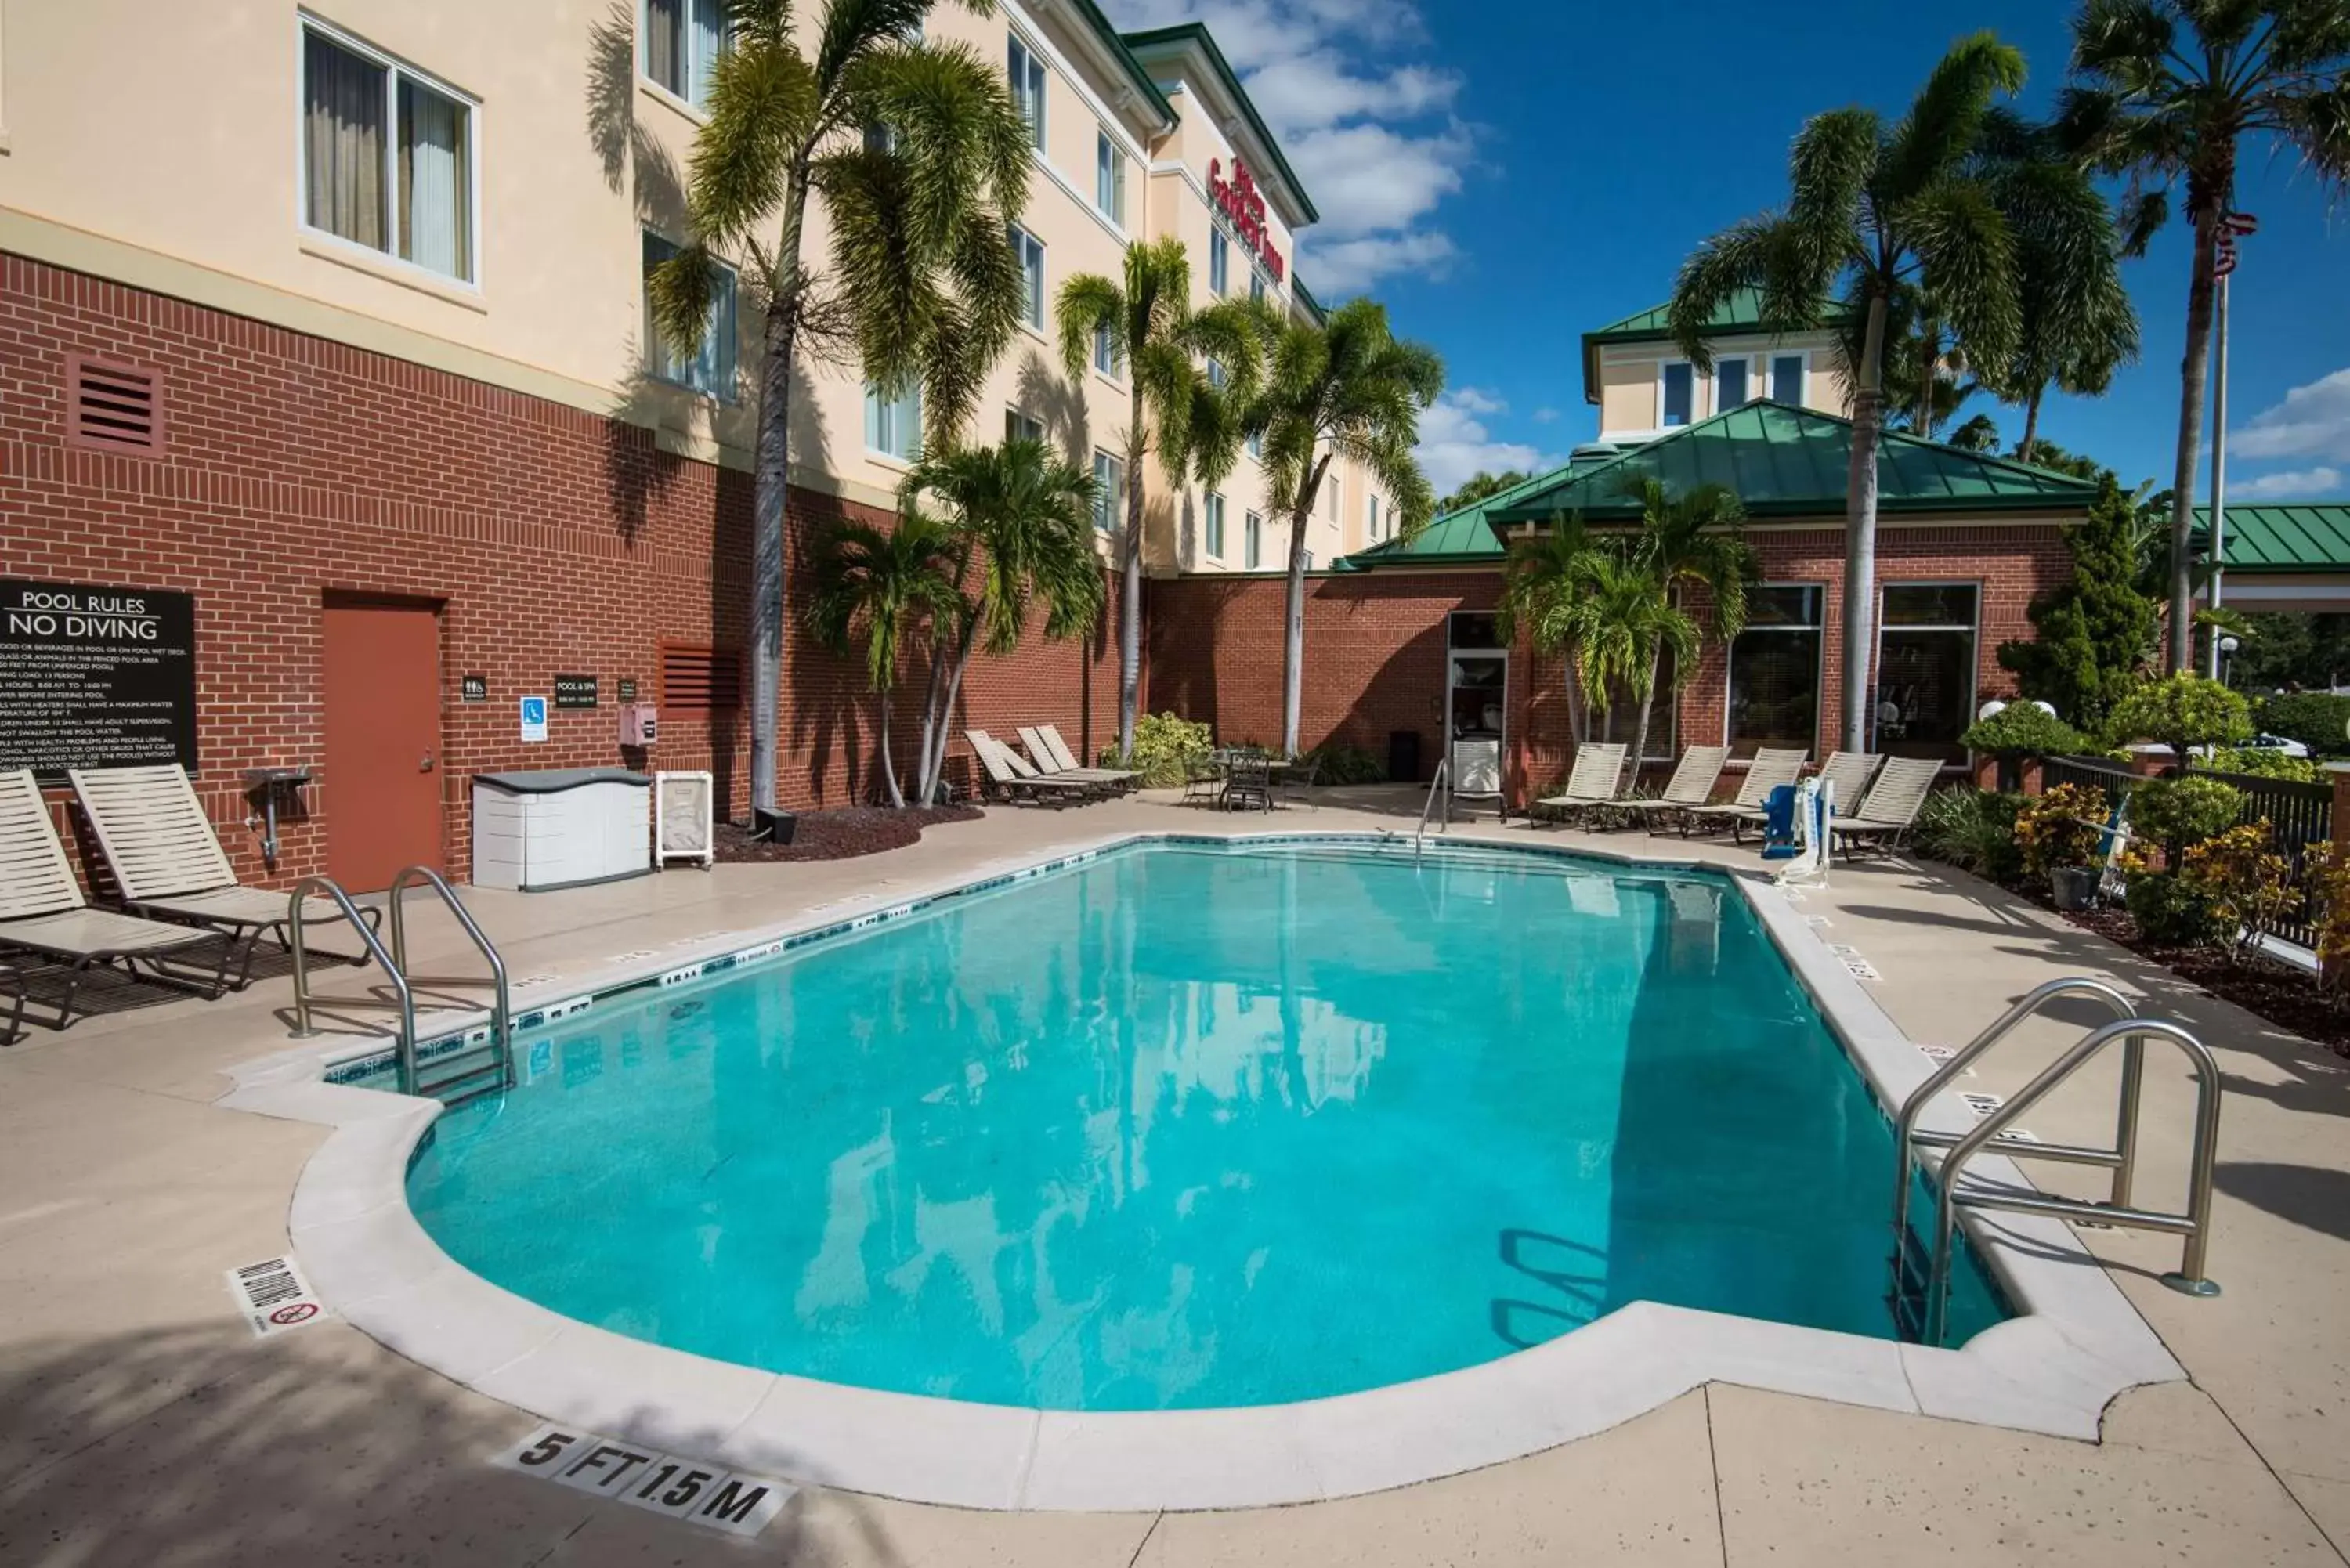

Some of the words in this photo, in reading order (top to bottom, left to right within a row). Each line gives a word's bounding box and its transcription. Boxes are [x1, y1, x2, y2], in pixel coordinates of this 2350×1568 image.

[22, 591, 82, 610] POOL
[88, 597, 146, 614] RULES
[9, 614, 57, 635] NO
[66, 617, 157, 640] DIVING
[519, 1433, 577, 1466] 5
[565, 1446, 649, 1487] FT
[635, 1464, 713, 1507] 1.5
[701, 1480, 770, 1524] M
